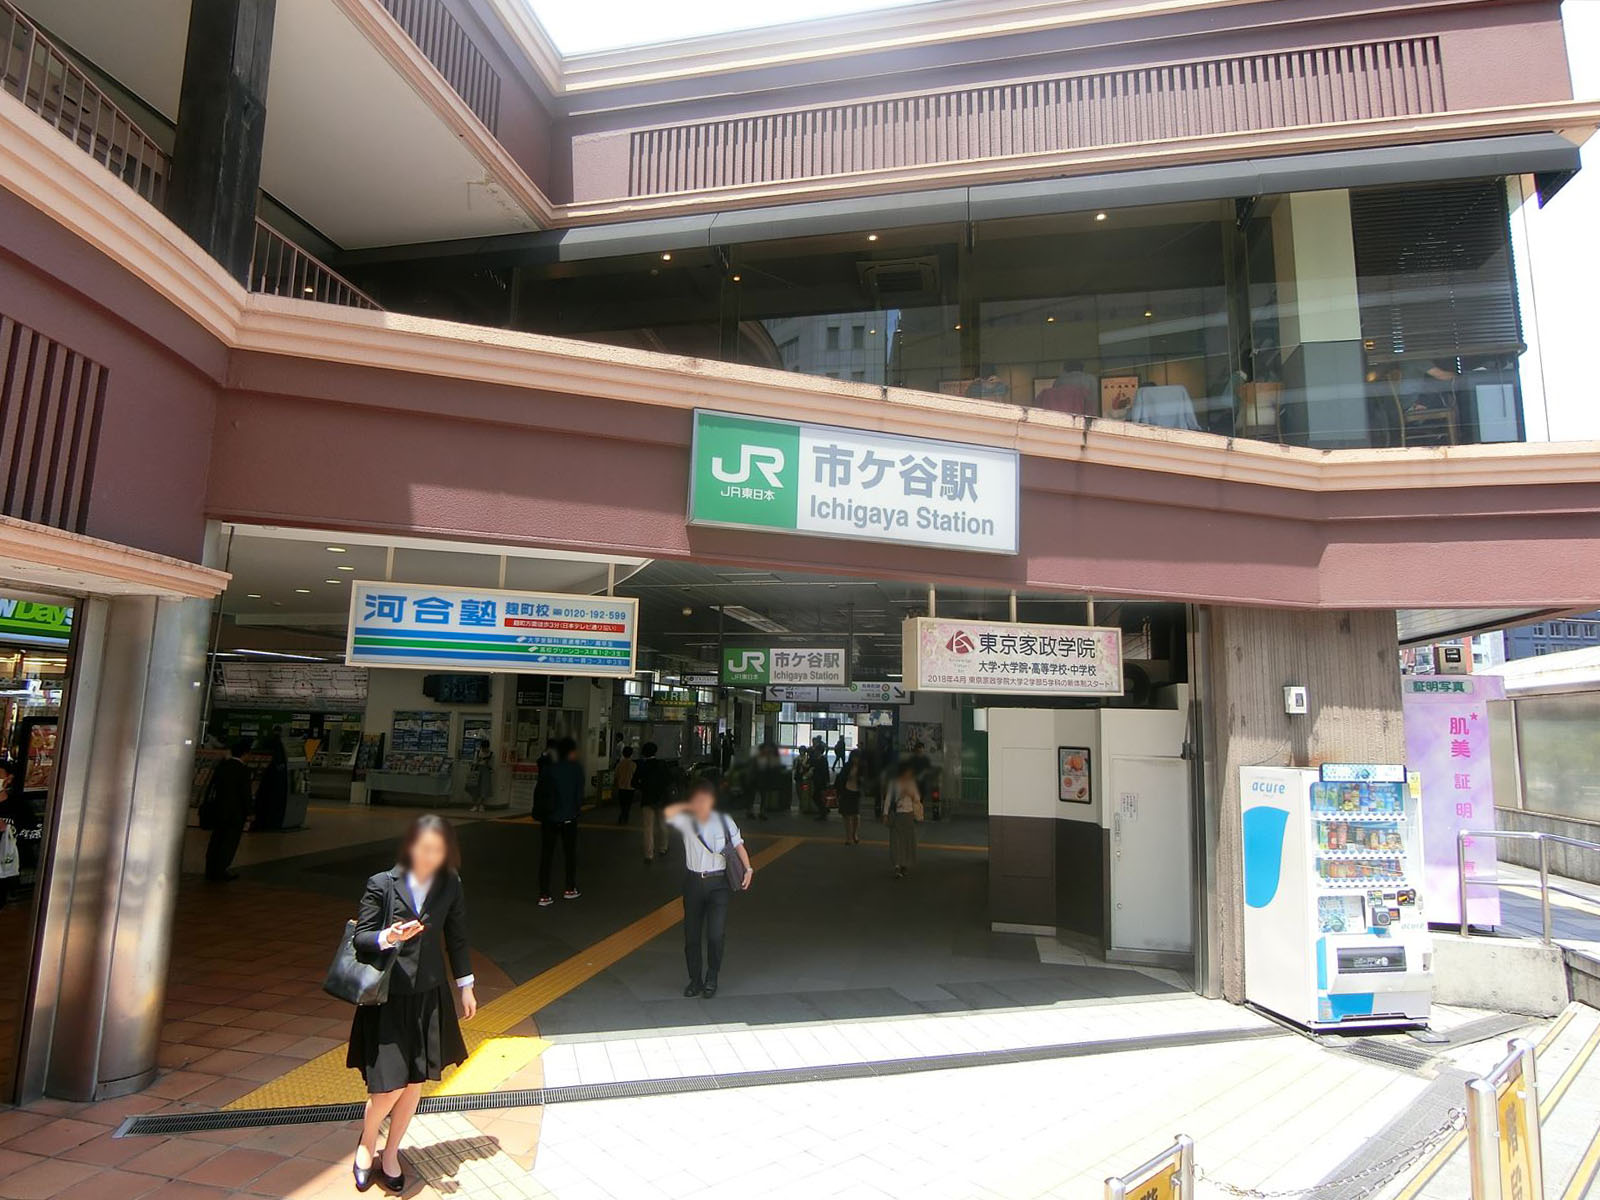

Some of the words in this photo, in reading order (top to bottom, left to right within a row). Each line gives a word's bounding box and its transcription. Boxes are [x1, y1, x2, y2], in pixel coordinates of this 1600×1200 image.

[711, 444, 785, 489] JR
[812, 444, 979, 503] 市ケ谷駅
[720, 485, 776, 502] JR東日本
[810, 494, 909, 531] Ichigaya
[916, 506, 995, 536] Station
[364, 593, 497, 628] 河合塾
[978, 632, 1096, 659] 東京家政学院
[728, 651, 765, 673] JR
[774, 651, 840, 669] 市ケ谷駅
[773, 670, 807, 682] Ichigaya
[809, 670, 840, 681] Station
[927, 675, 967, 684] 2018年4月
[1413, 681, 1465, 692] 証明写真
[1449, 717, 1471, 758] 肌美
[1251, 781, 1286, 794] acure
